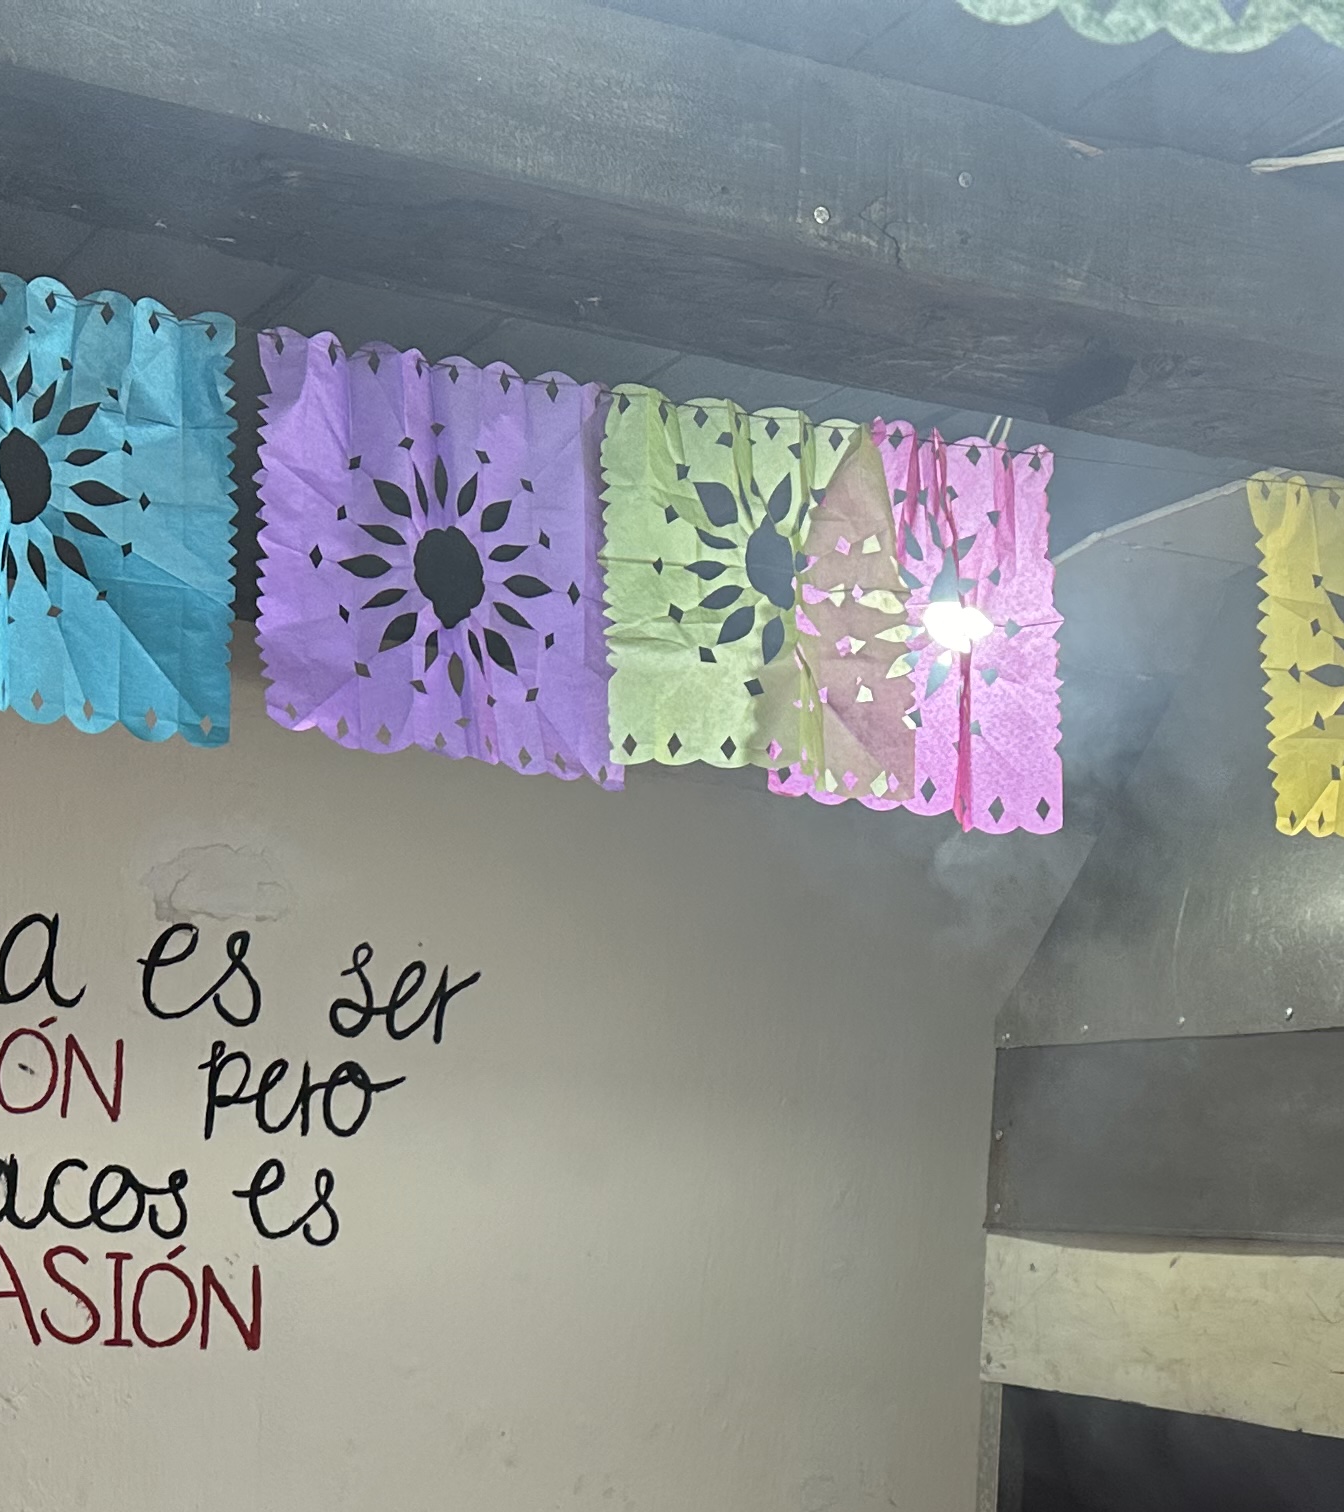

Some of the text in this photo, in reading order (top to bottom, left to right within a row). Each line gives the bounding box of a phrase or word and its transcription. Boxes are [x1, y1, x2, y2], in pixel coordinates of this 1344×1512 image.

[136, 922, 262, 1028] es
[328, 941, 481, 1045] ser
[201, 1039, 407, 1141] pero
[231, 1157, 340, 1248] es
